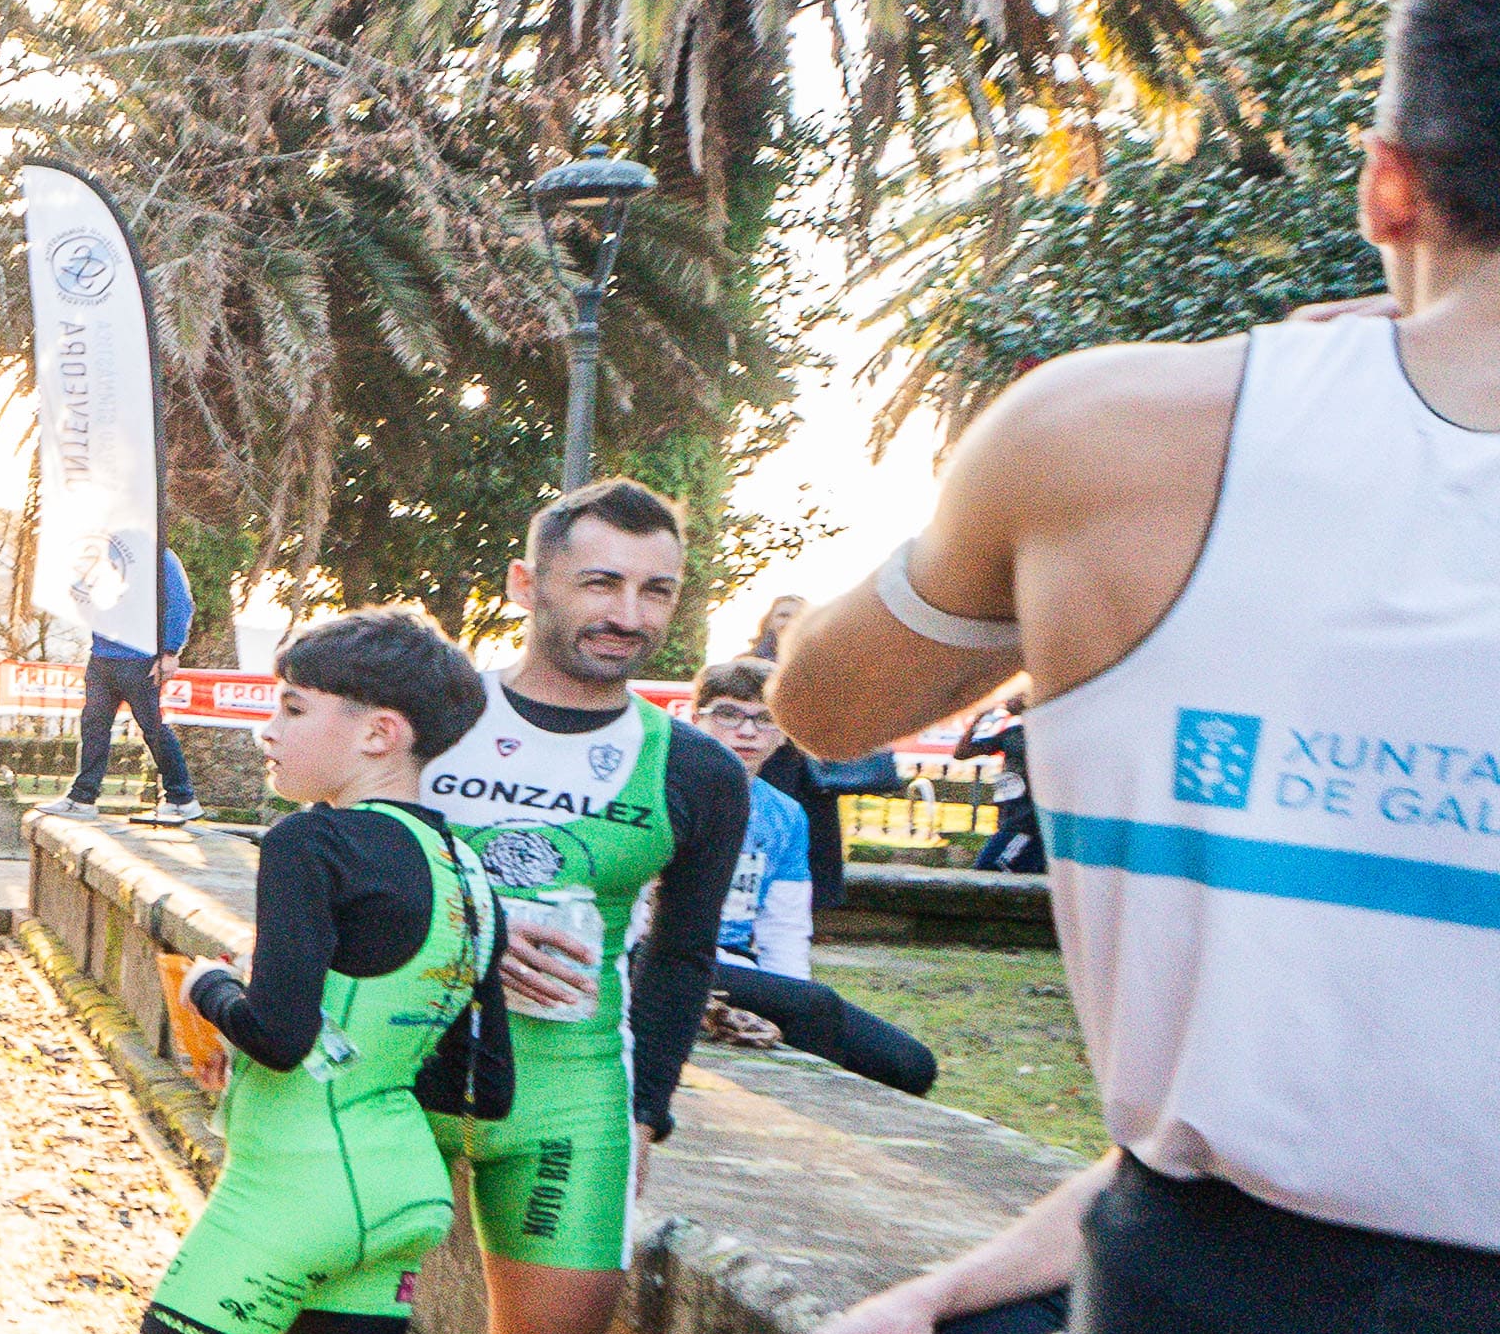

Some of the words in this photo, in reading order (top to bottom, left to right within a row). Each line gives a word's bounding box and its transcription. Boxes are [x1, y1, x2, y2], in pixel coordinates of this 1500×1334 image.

[1283, 727, 1500, 786] XUNTA
[431, 774, 654, 831] GONZALEZ
[1276, 771, 1356, 817] DE
[521, 1185, 566, 1240] MOTO
